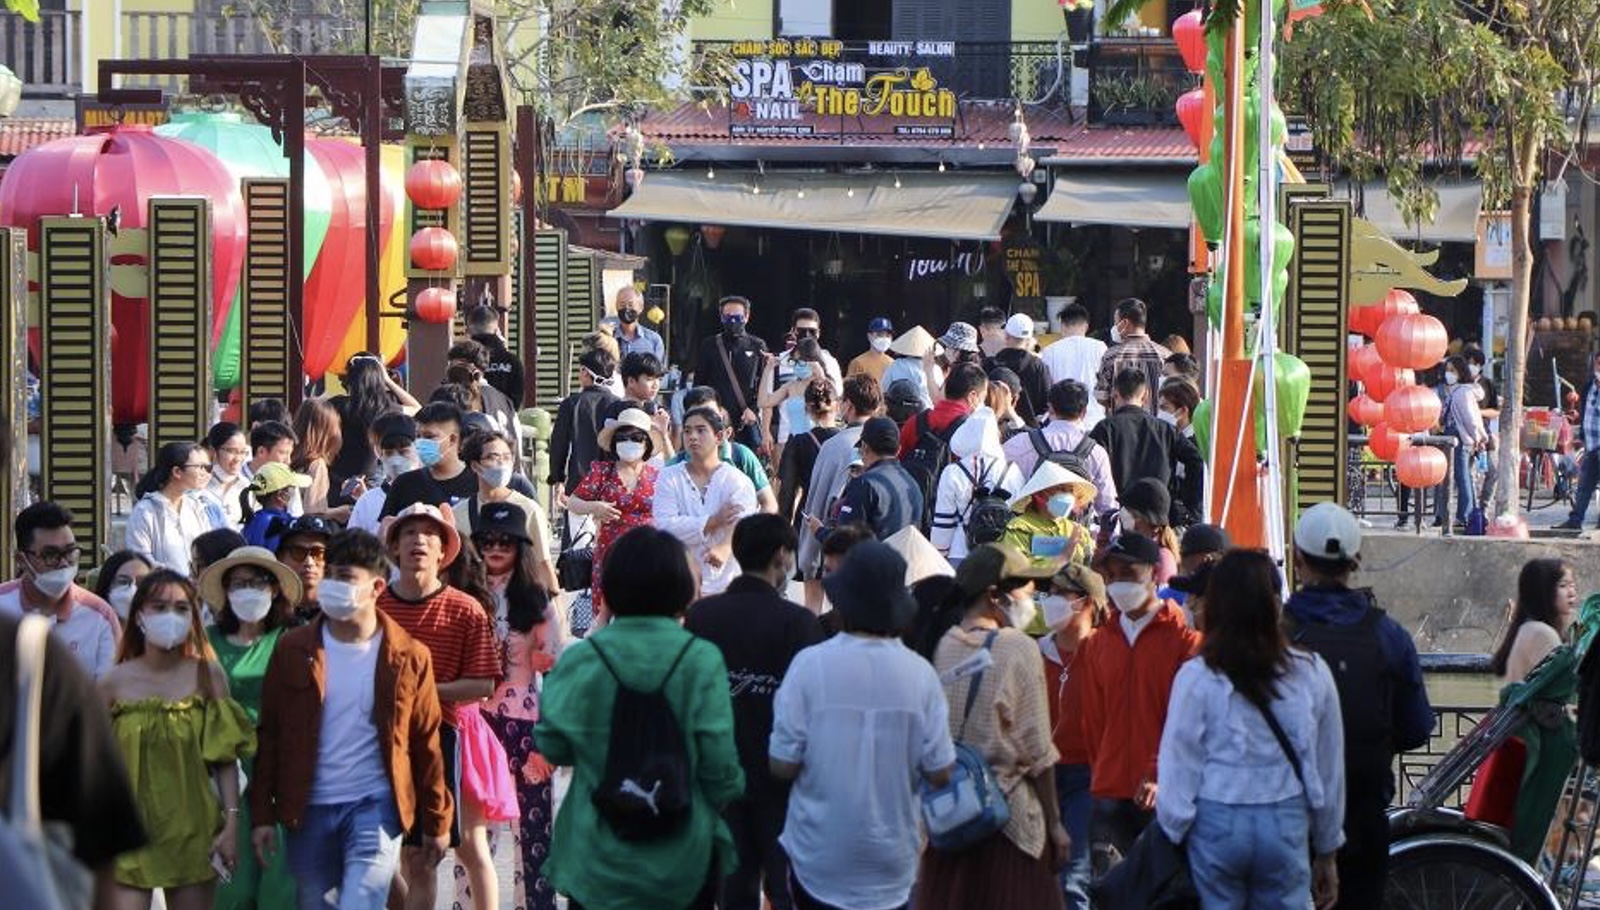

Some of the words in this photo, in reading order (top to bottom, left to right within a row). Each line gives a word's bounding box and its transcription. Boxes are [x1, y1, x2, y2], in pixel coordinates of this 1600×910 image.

[868, 41, 909, 55] BEAUTY
[916, 41, 952, 55] SALON
[731, 60, 792, 98] SPA
[815, 87, 858, 115] The
[863, 67, 953, 117] Touch
[757, 102, 800, 119] NAIL
[1016, 271, 1040, 296] SPA
